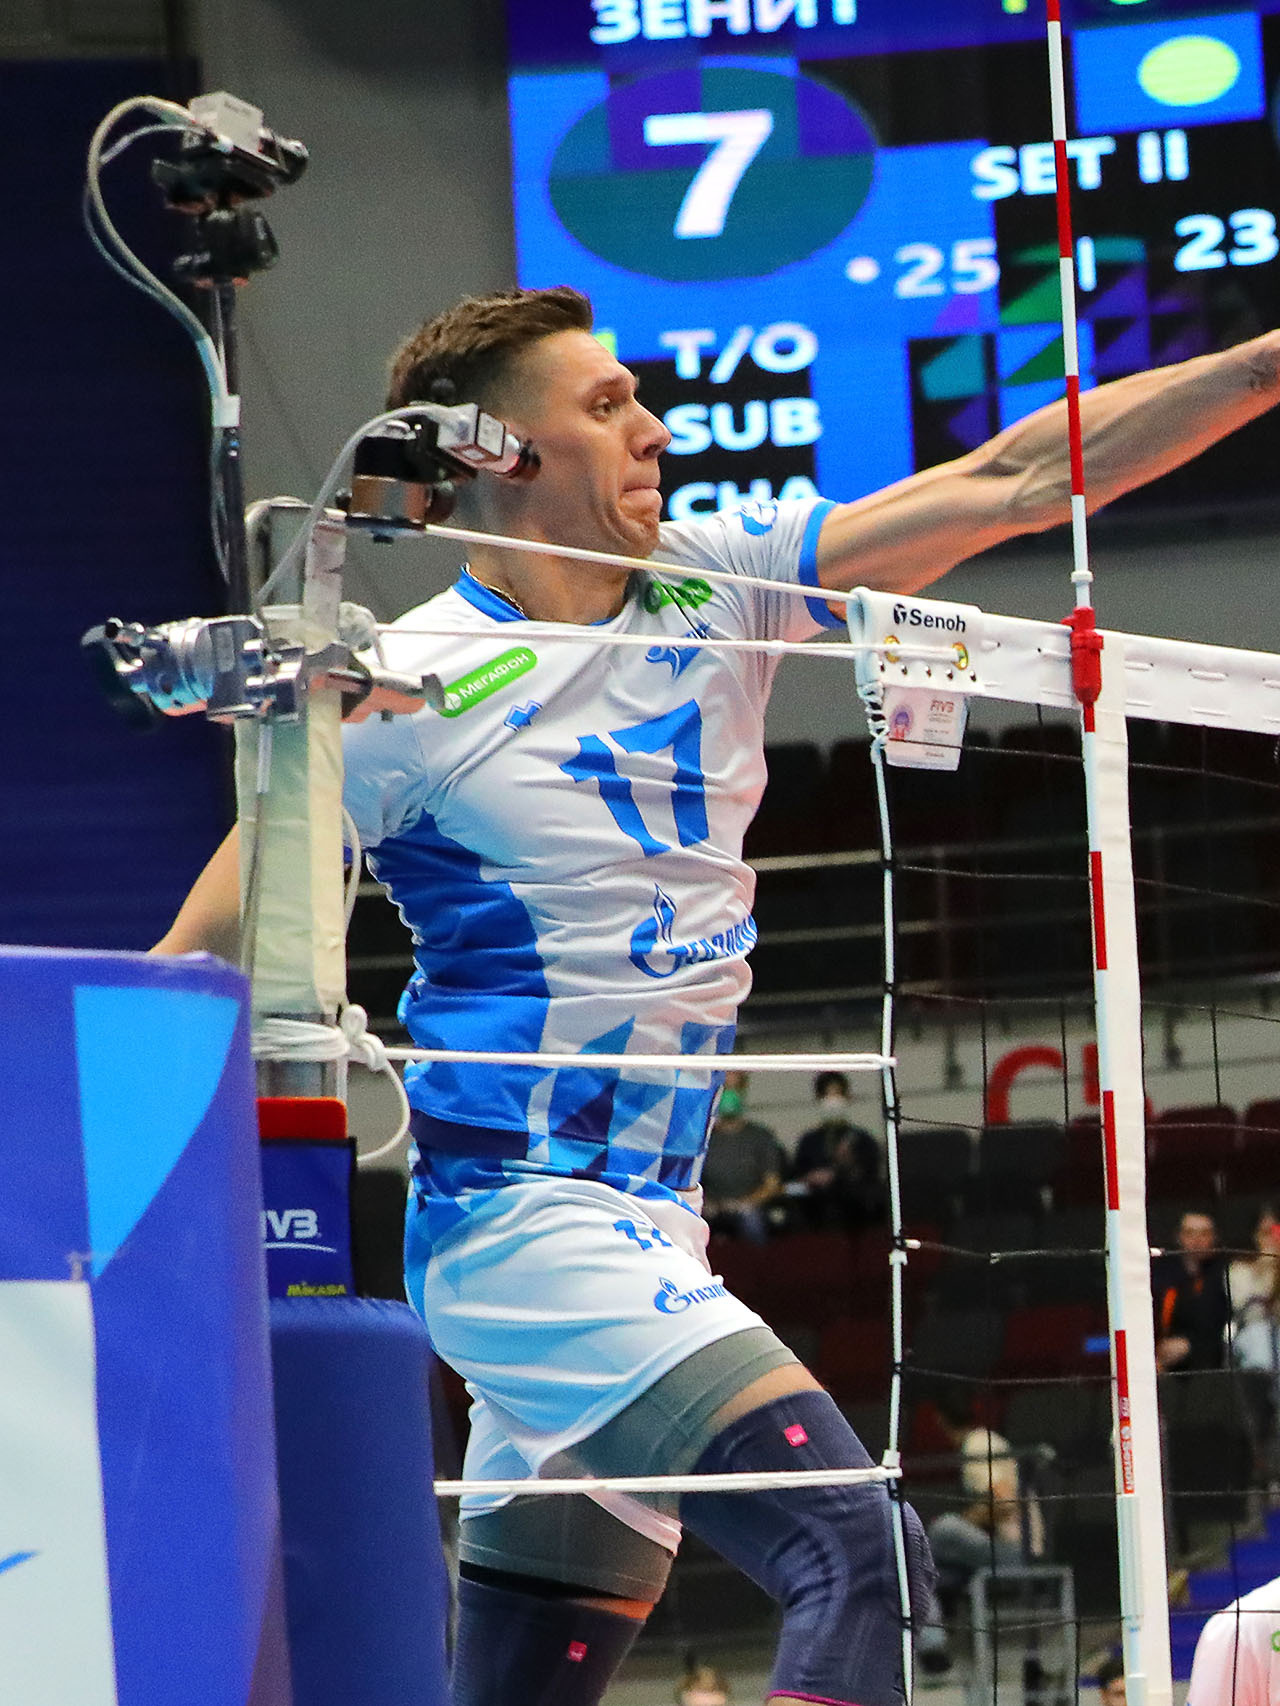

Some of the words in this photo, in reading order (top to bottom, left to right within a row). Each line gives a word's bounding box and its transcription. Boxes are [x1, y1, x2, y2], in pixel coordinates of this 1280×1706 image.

[643, 109, 774, 239] 7
[970, 135, 1117, 200] SET
[1137, 128, 1190, 184] II
[893, 238, 1000, 299] 25
[1173, 208, 1280, 272] 23
[659, 321, 819, 384] T/O
[664, 397, 823, 455] SUB
[909, 609, 967, 633] Senoh
[459, 652, 529, 699] МЕГАФОН
[559, 699, 709, 858] 17
